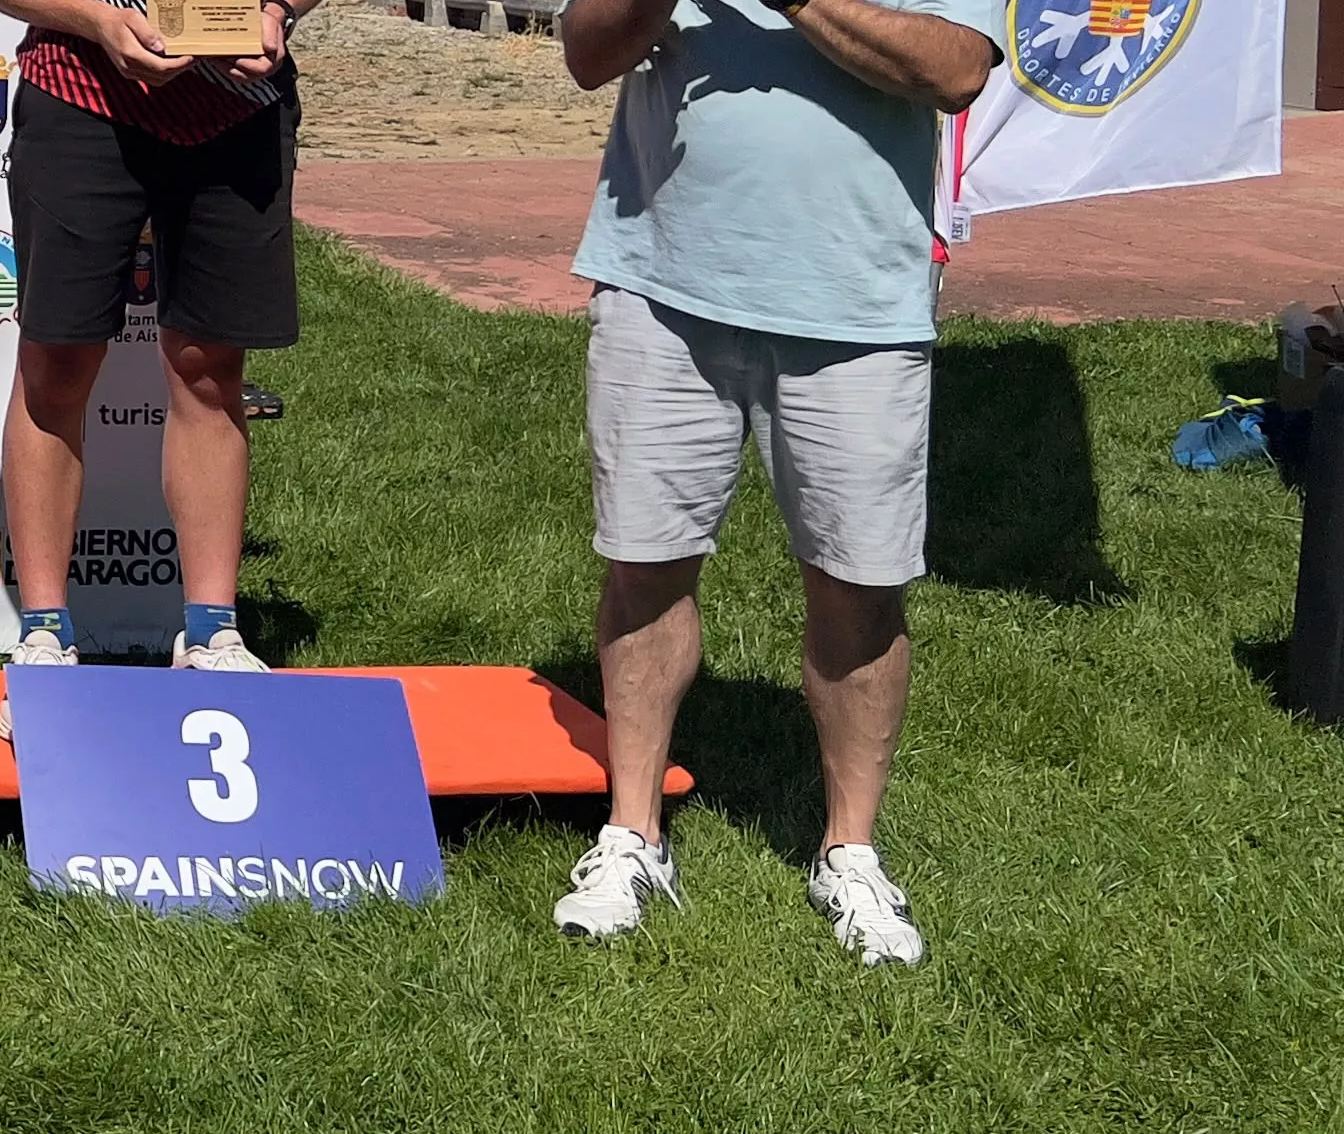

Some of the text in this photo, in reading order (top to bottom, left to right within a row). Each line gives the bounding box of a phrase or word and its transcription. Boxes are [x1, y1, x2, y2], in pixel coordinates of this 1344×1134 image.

[1017, 27, 1082, 101] DEPORTES
[1086, 87, 1111, 102] DE
[135, 329, 158, 343] Aís
[98, 403, 164, 426] turis
[66, 559, 183, 585] ARAGO
[181, 709, 259, 823] 3
[65, 855, 404, 901] SPAINSNOW
